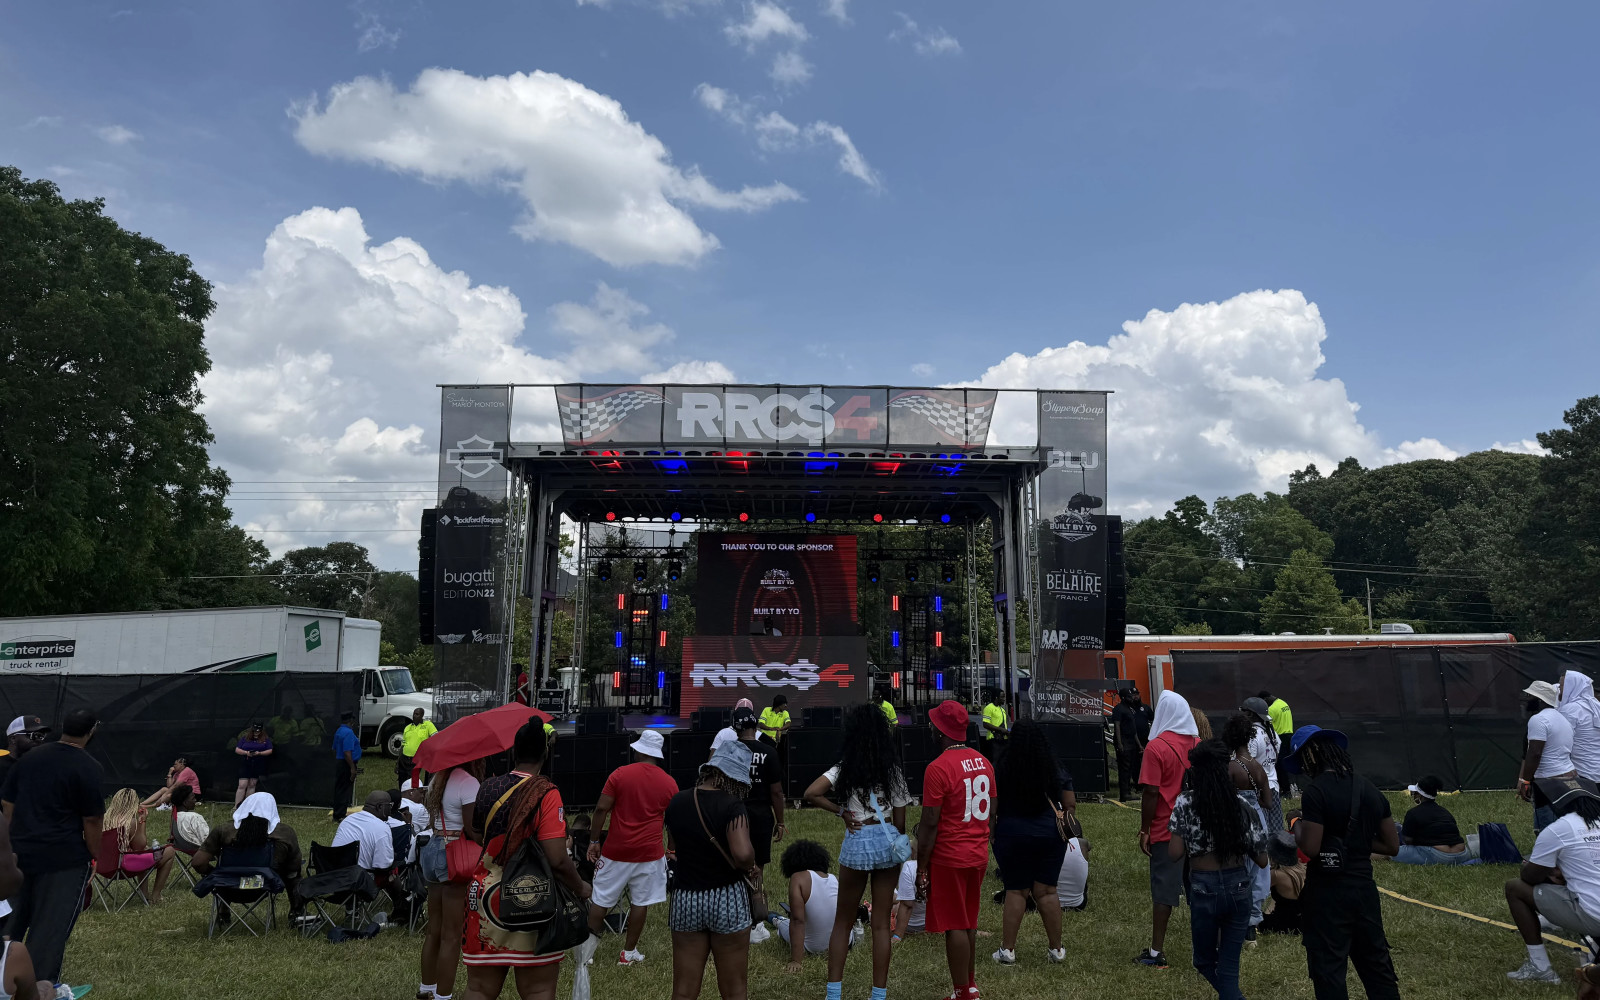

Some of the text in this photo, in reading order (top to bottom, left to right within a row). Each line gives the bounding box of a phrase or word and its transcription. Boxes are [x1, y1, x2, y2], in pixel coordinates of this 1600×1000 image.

[1050, 523, 1070, 531] BUILT
[721, 543, 834, 551] THANK YOU TO OUR SPONSOR
[444, 567, 495, 587] bugatti
[1046, 573, 1102, 593] BELAIRE
[1056, 594, 1090, 602] FRANCE
[754, 607, 800, 615] BUILT BY YO
[1041, 629, 1068, 645] RAP
[1, 643, 74, 657] enterprise
[9, 659, 62, 669] truck rental
[1037, 693, 1067, 702] BUMBU
[960, 757, 987, 773] KELCE
[961, 774, 991, 823] 18
[468, 880, 480, 911] 49ERS
